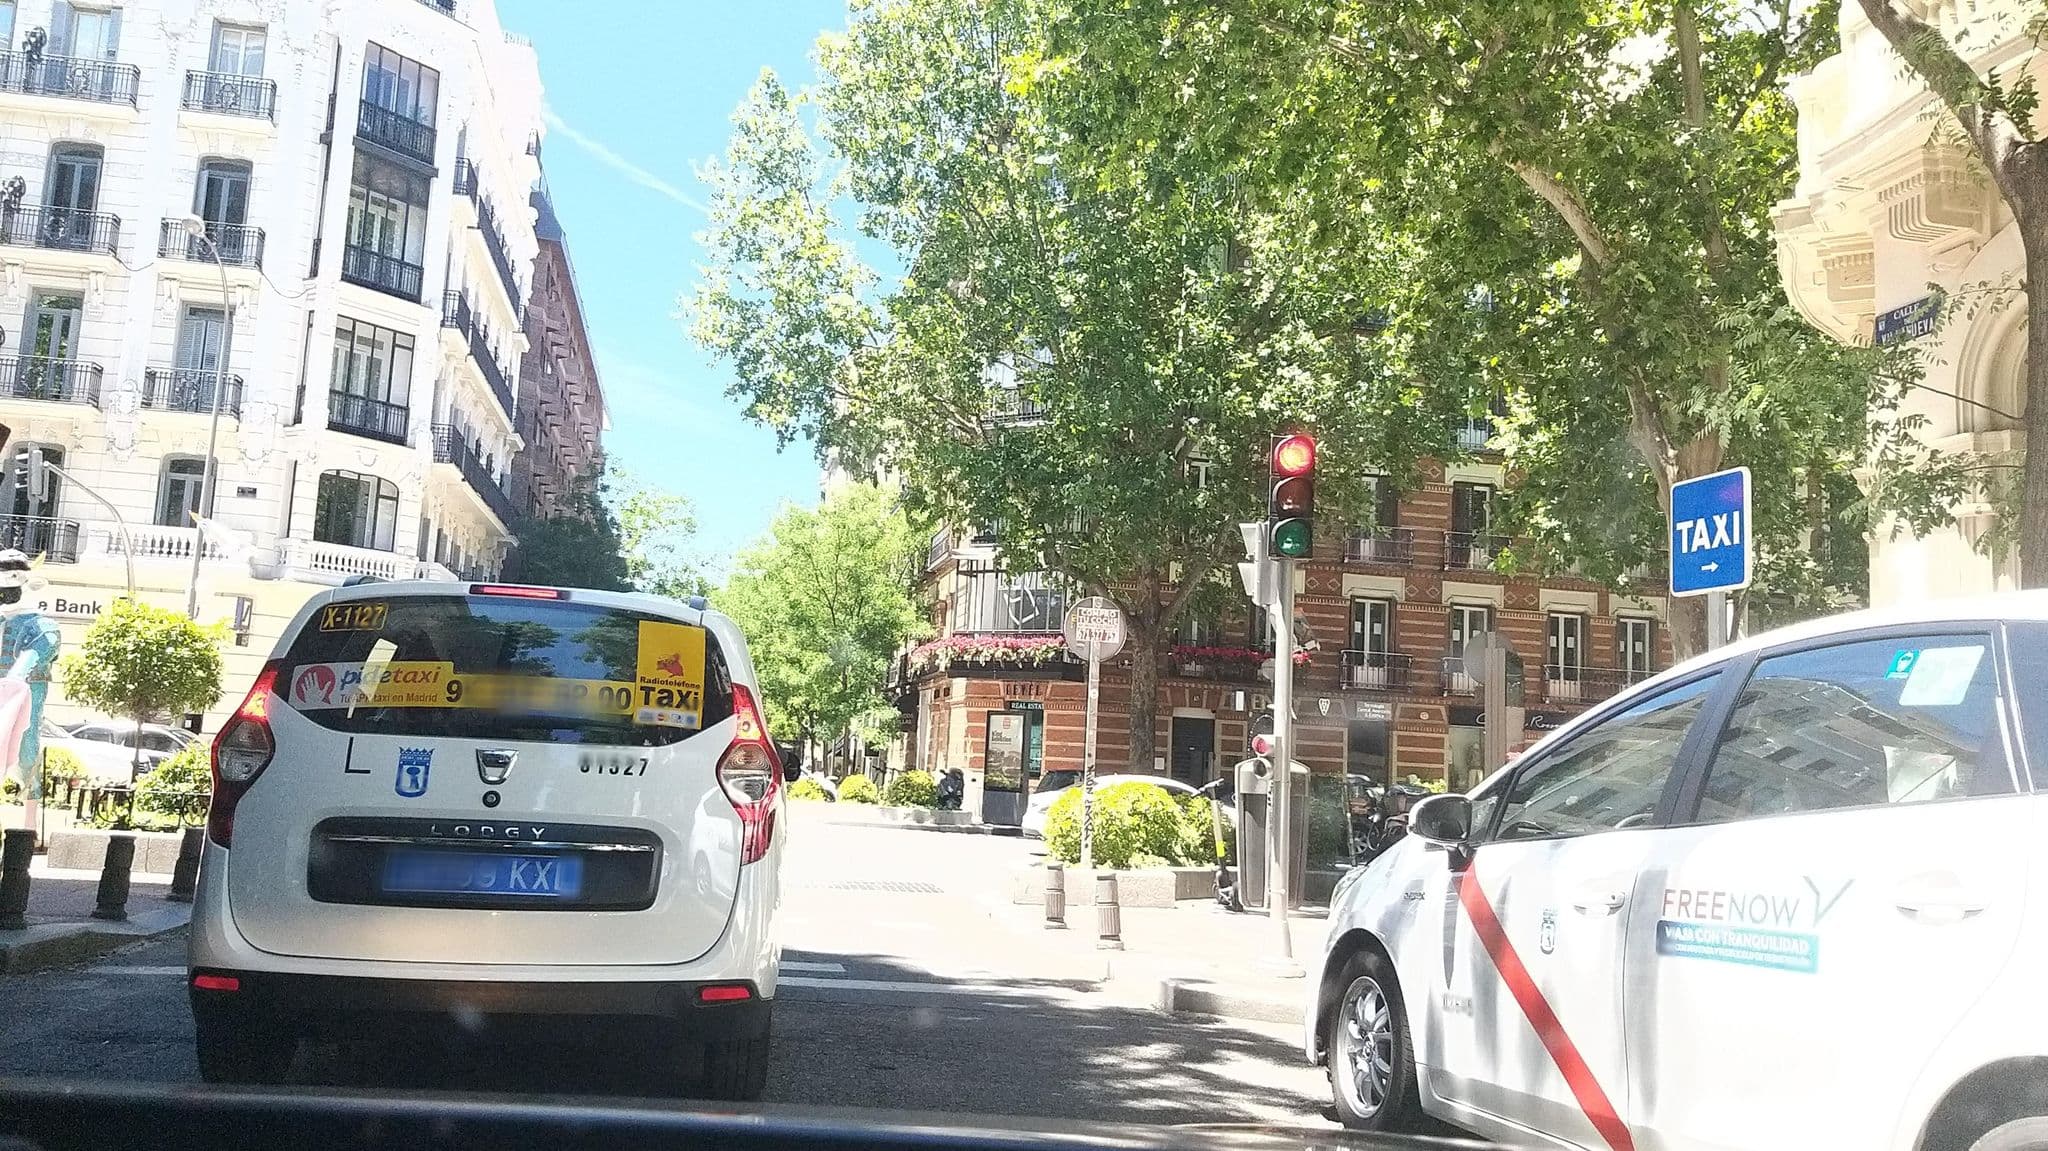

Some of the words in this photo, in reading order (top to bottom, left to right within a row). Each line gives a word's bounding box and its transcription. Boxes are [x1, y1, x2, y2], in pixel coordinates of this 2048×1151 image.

[1676, 511, 1740, 553] TAXI
[55, 598, 102, 614] Bank
[323, 603, 385, 629] X-1127
[406, 692, 437, 703] Madrid
[344, 736, 371, 774] L
[431, 823, 545, 839] LODGY
